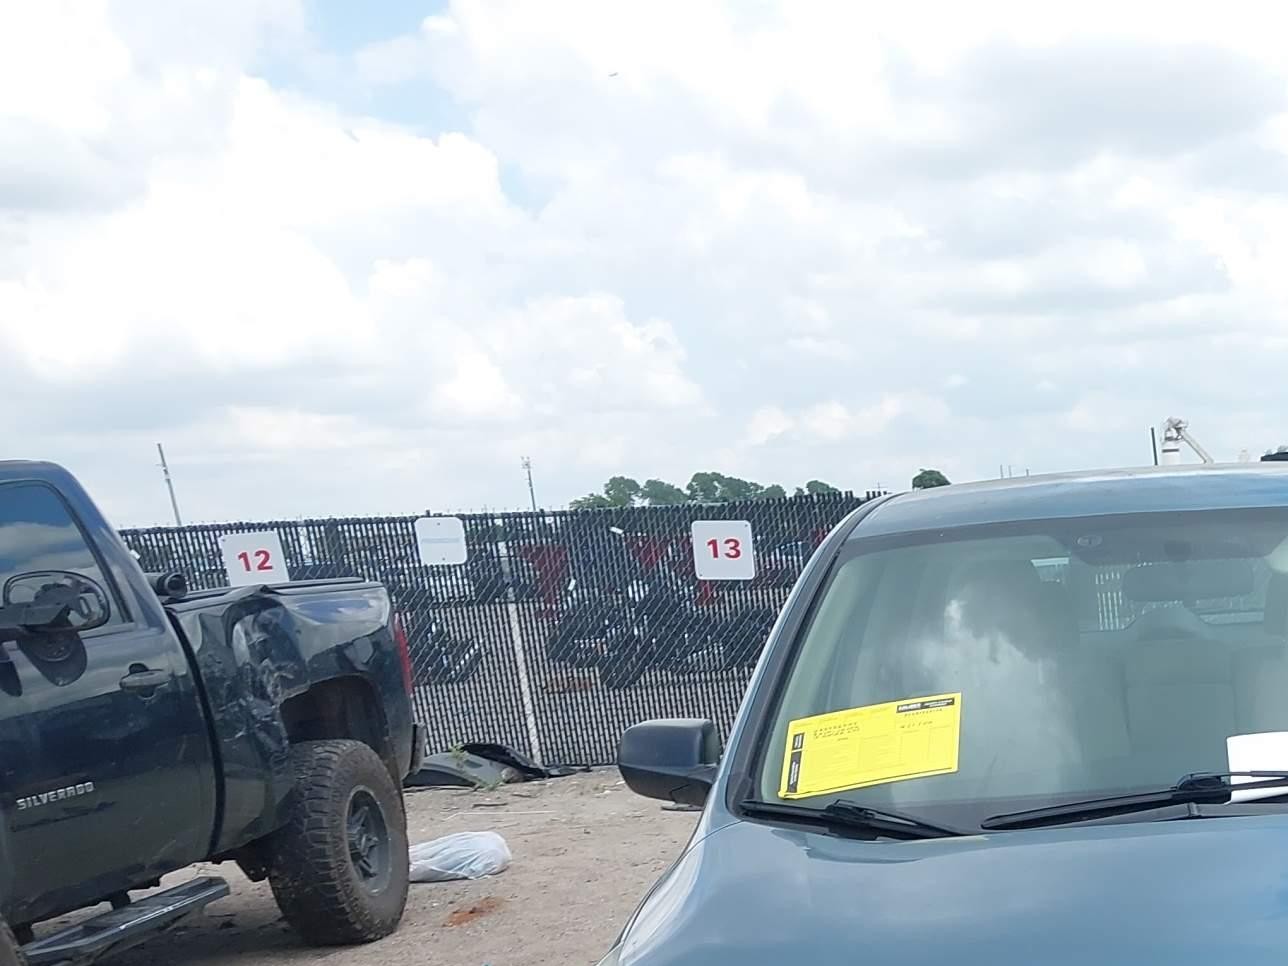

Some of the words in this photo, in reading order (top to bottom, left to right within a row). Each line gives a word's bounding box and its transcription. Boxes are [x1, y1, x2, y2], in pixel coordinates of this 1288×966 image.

[238, 549, 273, 572] 12
[706, 538, 742, 560] 13
[16, 781, 94, 810] SILVERADO
